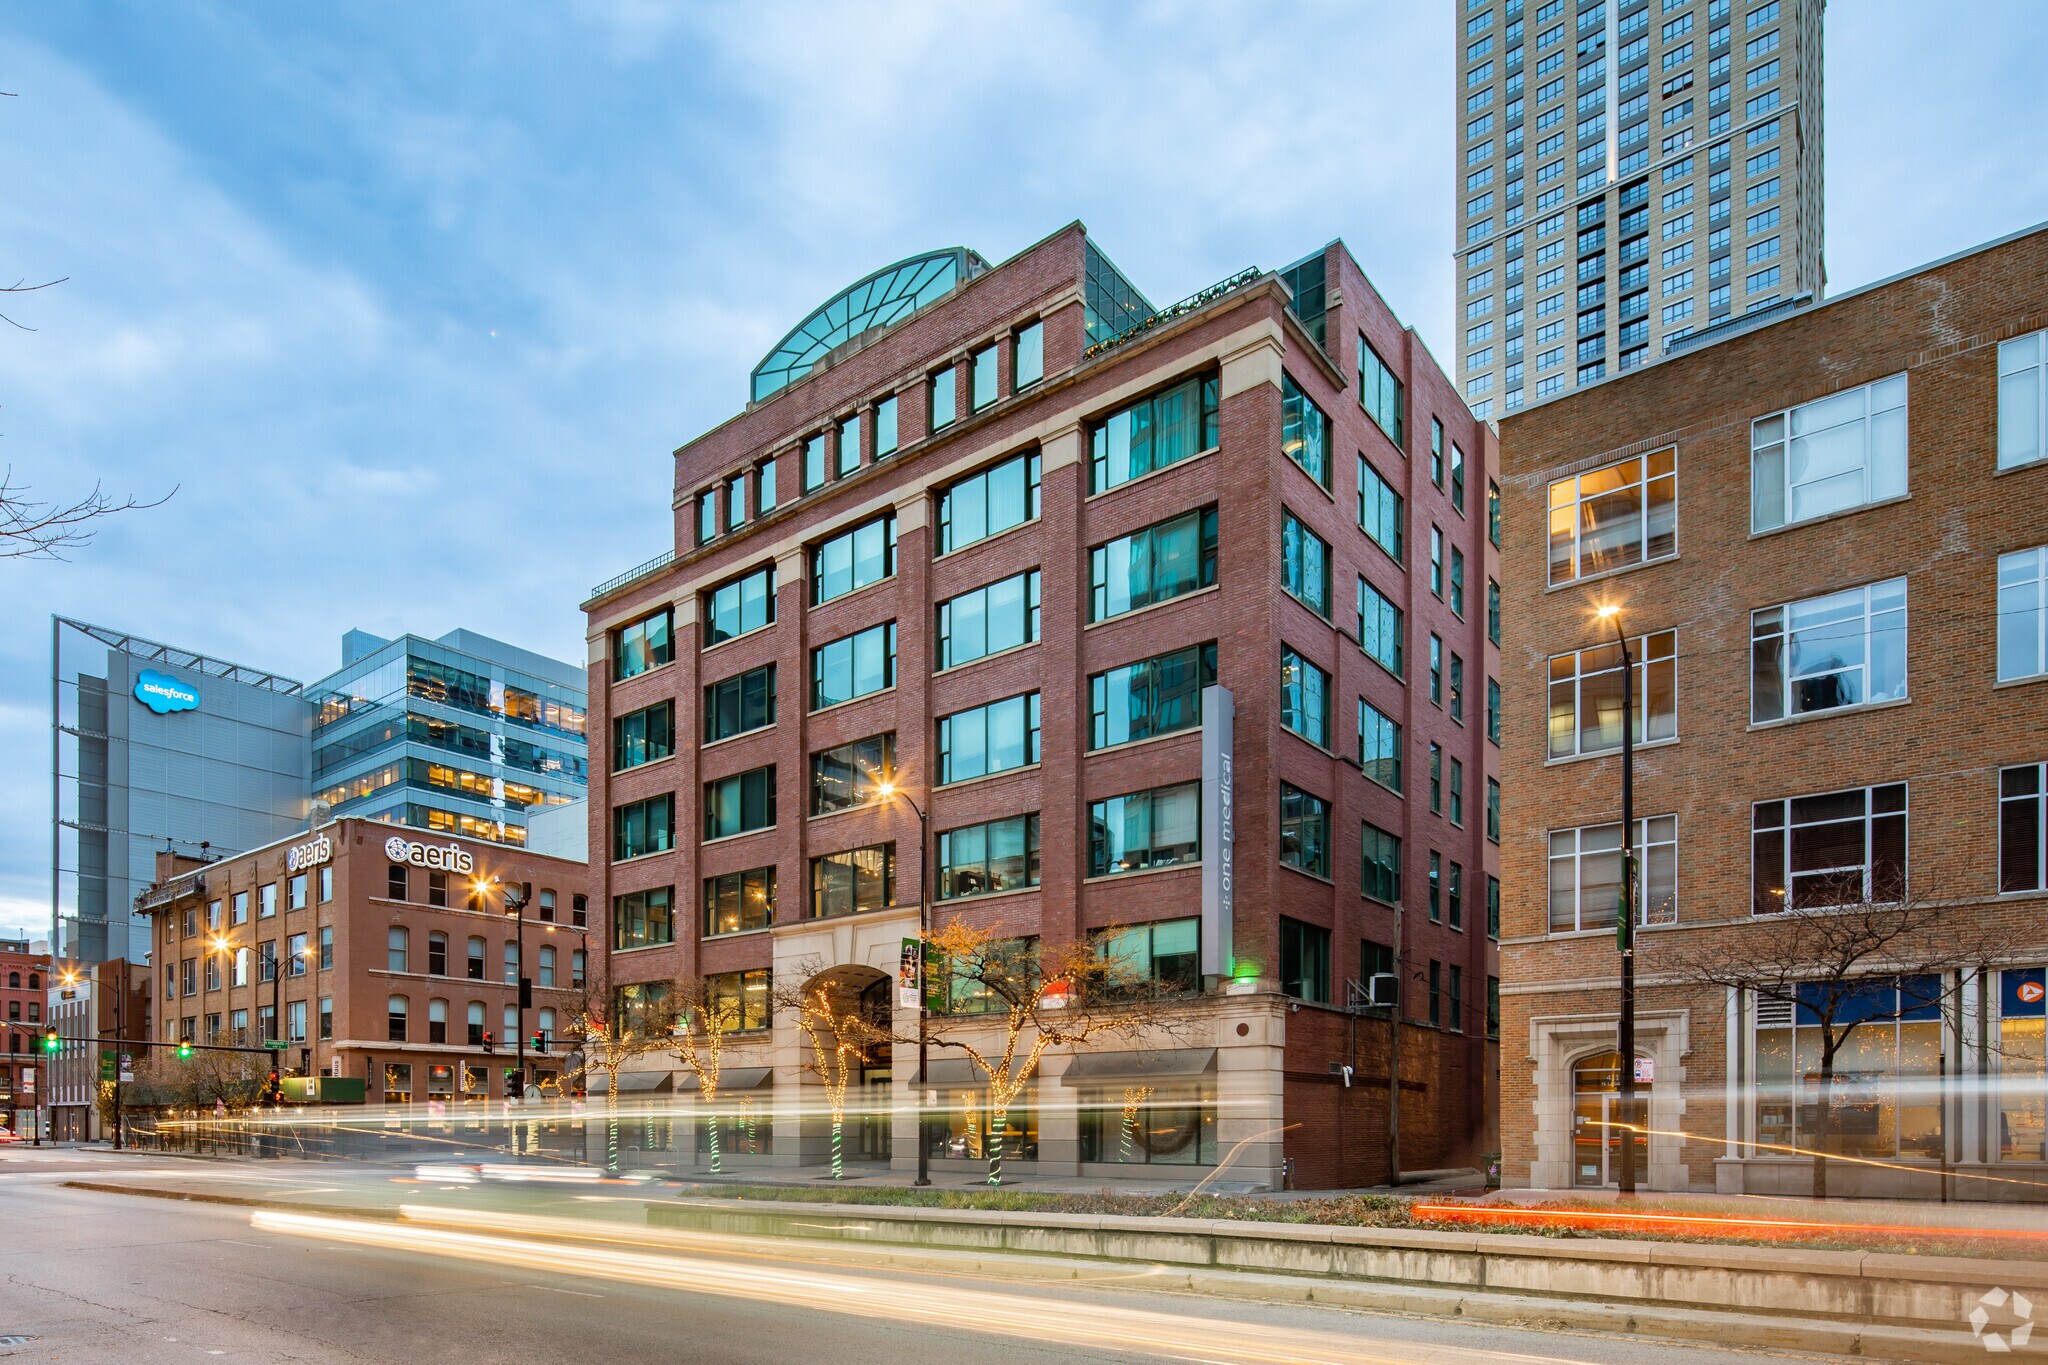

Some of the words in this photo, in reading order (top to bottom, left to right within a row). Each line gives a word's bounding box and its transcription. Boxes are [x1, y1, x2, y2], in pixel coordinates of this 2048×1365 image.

[143, 683, 194, 702] salesforce
[1221, 752, 1231, 842] medical
[298, 833, 328, 867] aeris
[410, 843, 472, 872] aeris
[1222, 847, 1231, 892] one
